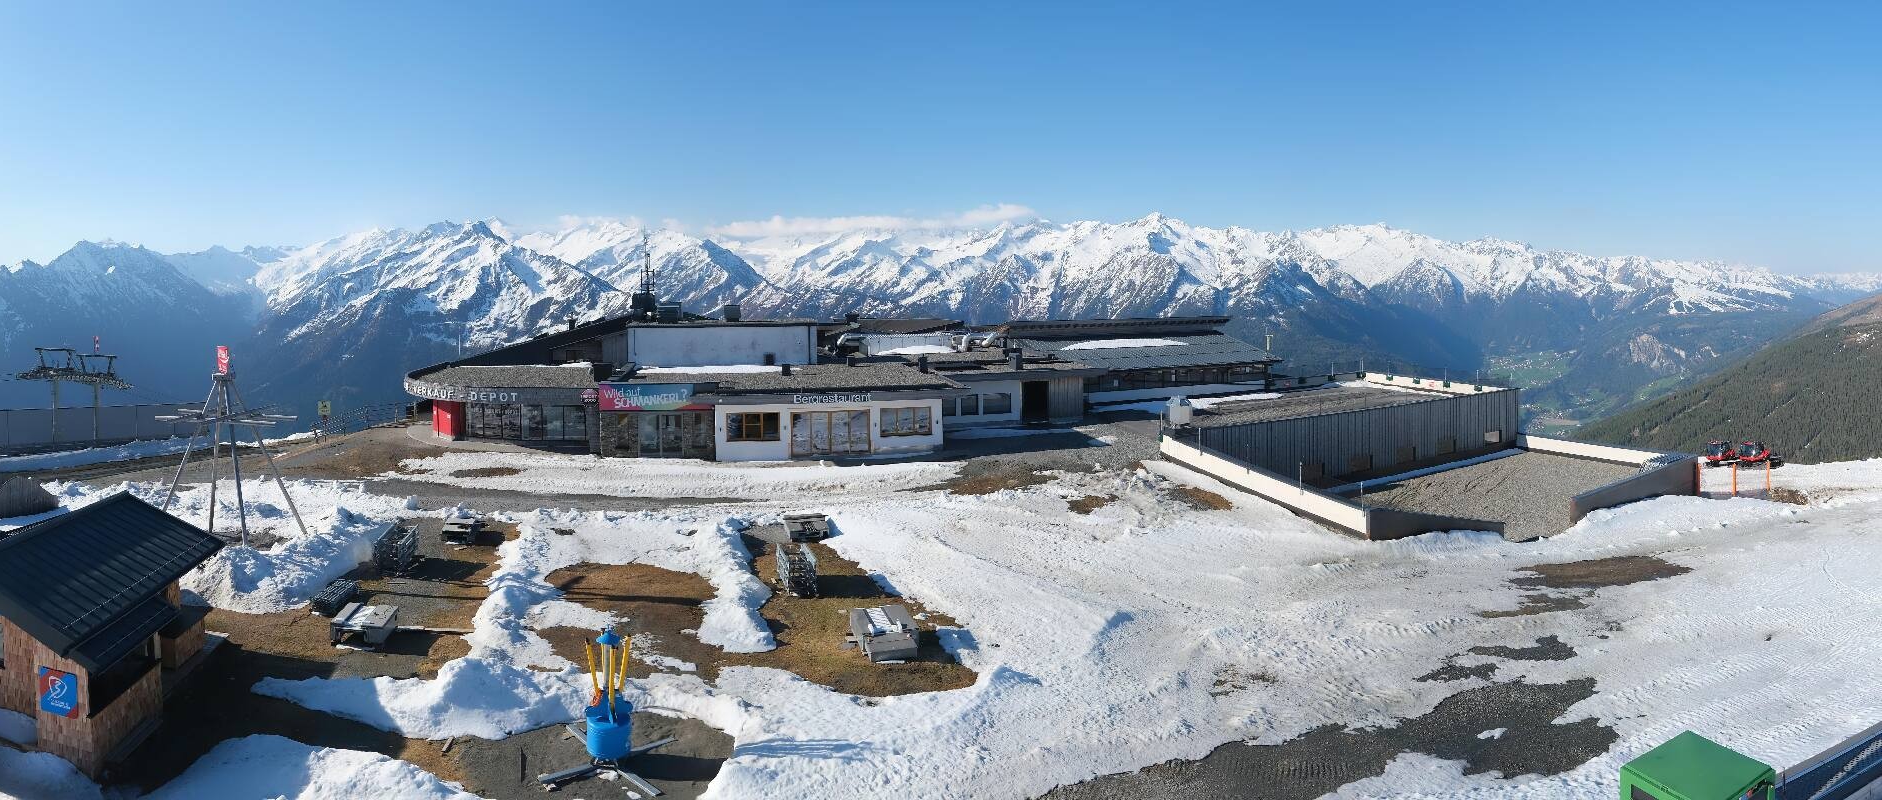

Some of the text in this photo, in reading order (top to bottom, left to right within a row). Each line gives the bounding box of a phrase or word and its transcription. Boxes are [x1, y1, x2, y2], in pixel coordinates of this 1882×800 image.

[413, 385, 454, 399] VERKAUF
[469, 391, 518, 402] DEPOT
[604, 387, 641, 399] Wild auf
[614, 388, 688, 408] SCHMANKERL?
[793, 392, 872, 404] Bergrestaurant
